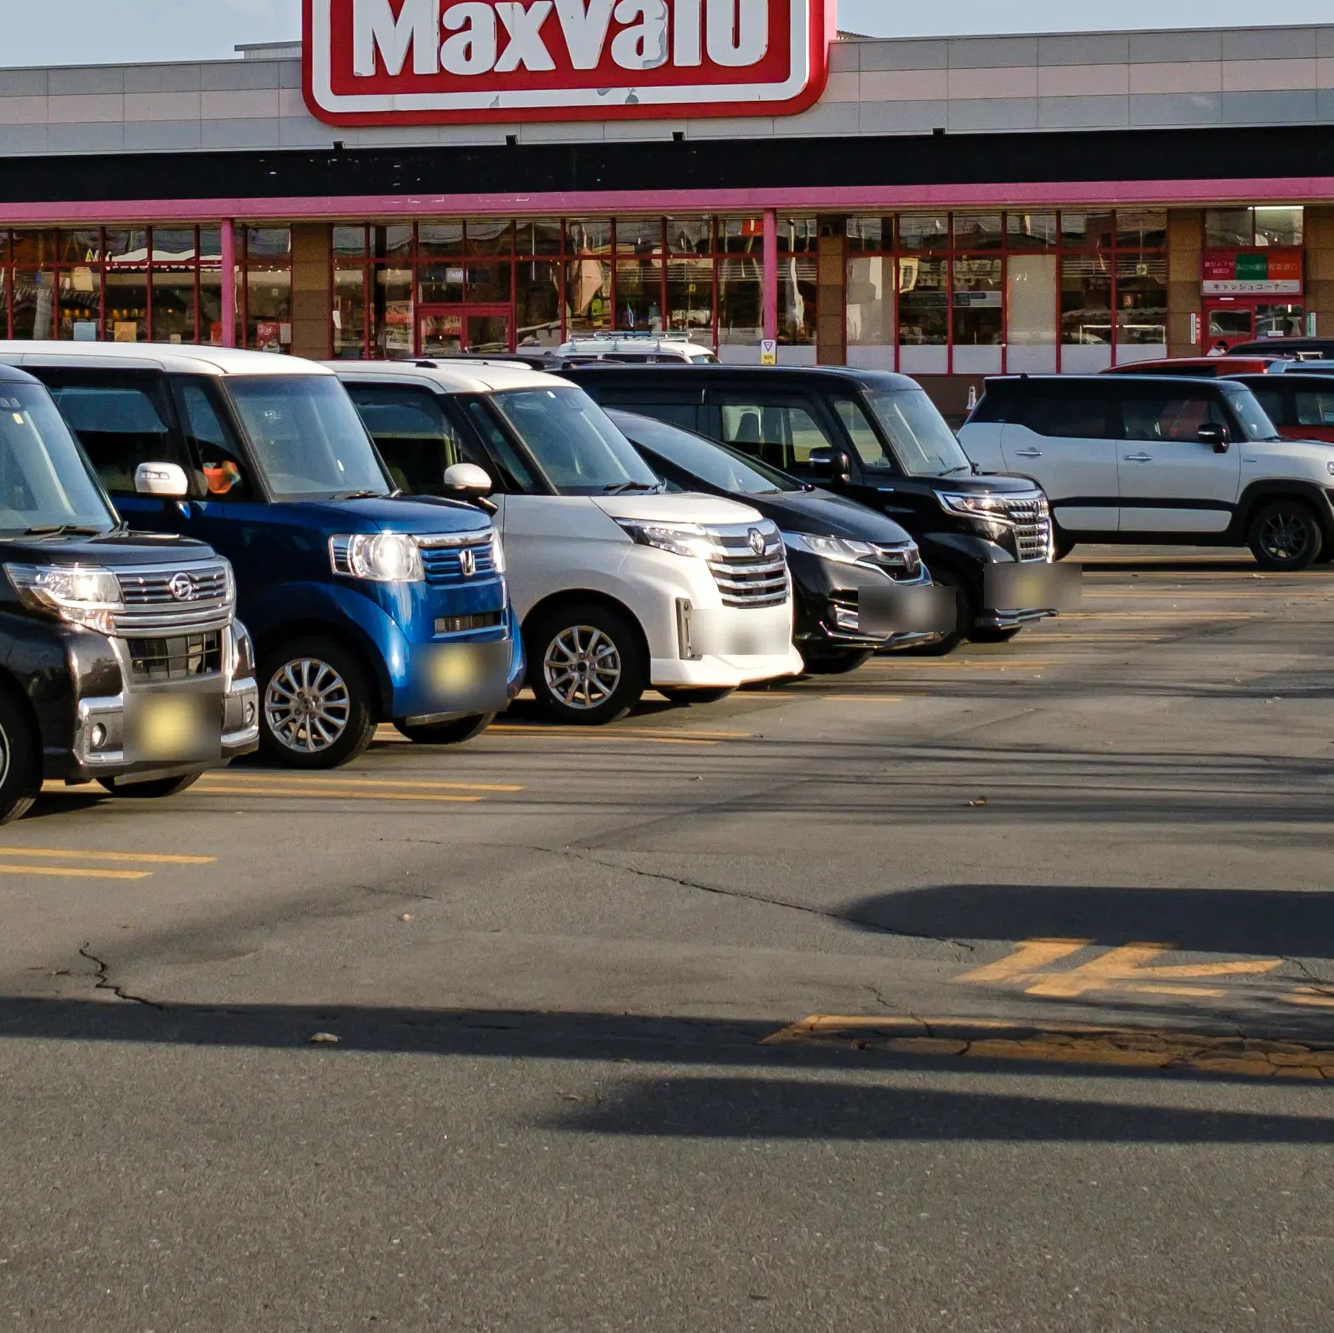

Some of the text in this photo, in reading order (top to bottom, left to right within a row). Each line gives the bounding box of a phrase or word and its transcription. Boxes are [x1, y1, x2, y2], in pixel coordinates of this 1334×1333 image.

[1213, 283, 1290, 291] キャッシュコーナー
